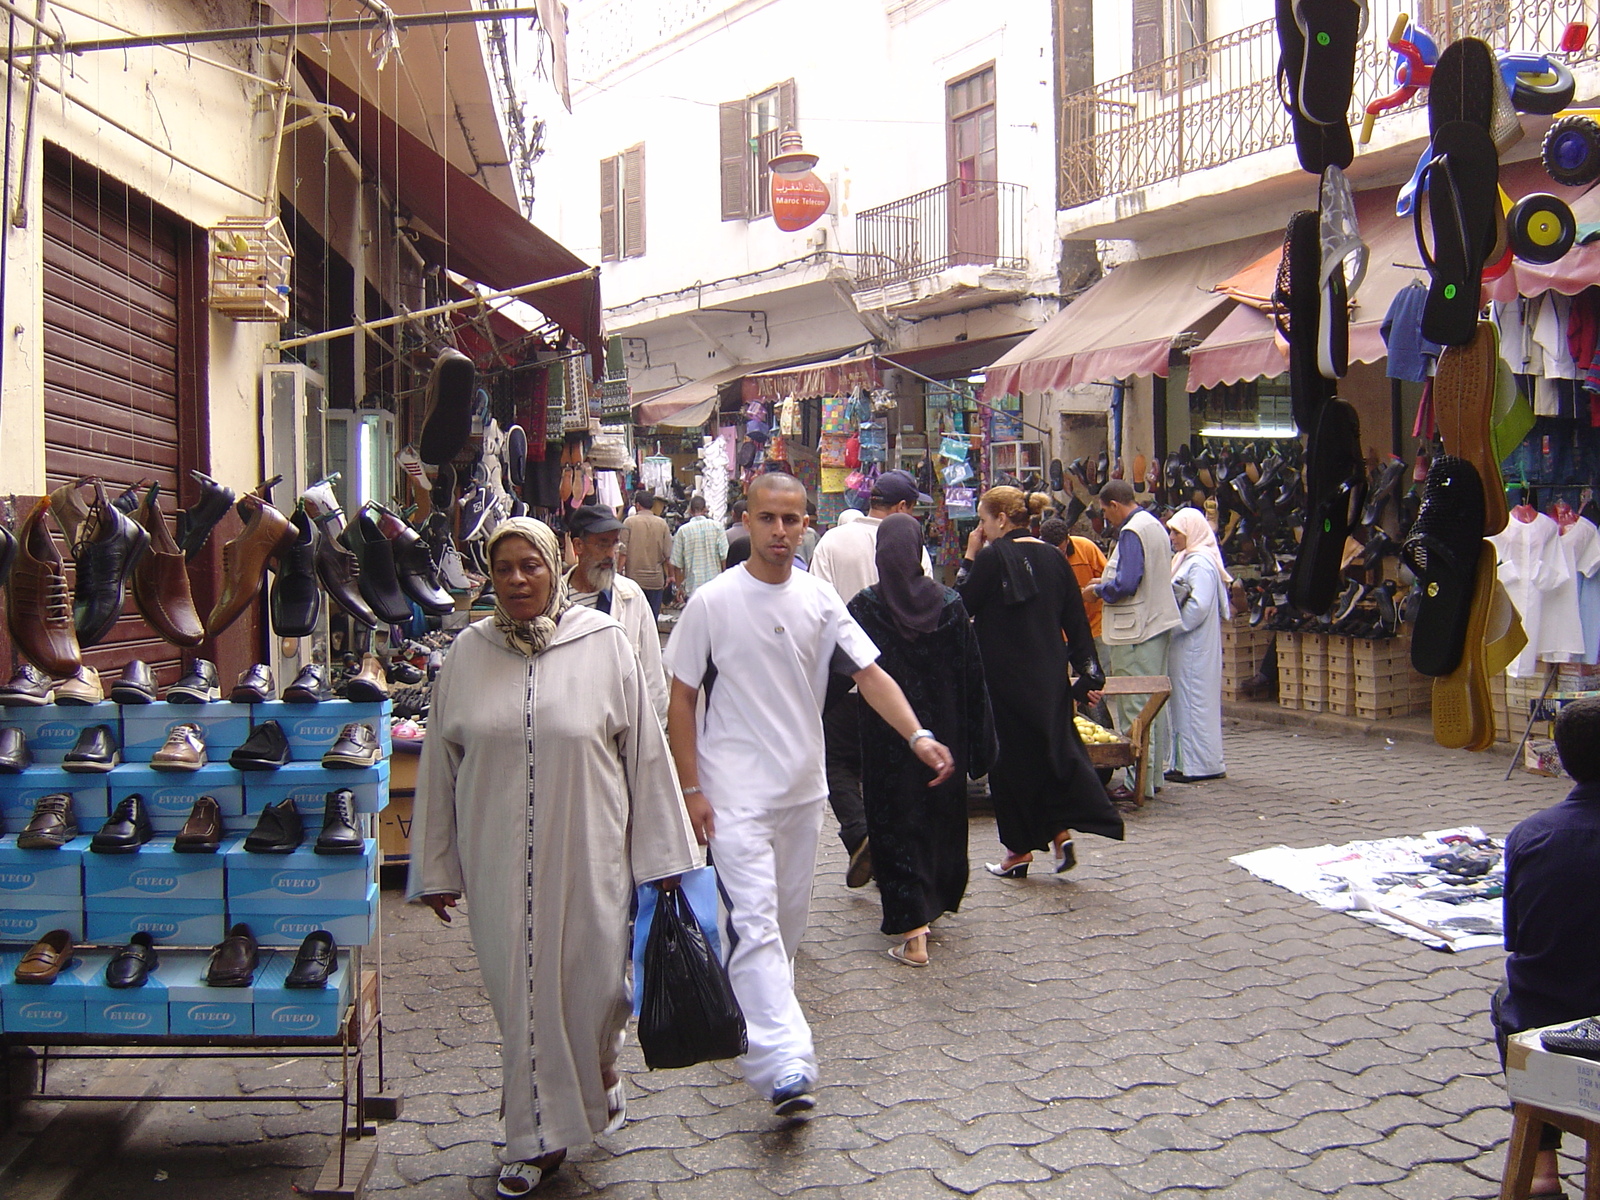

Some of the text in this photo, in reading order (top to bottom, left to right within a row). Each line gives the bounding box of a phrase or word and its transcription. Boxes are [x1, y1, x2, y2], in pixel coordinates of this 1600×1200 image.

[776, 197, 825, 206] Maroc Telecom
[41, 728, 75, 737] EVECO
[300, 726, 335, 735] EVECO
[158, 795, 195, 804] EVECO
[294, 794, 327, 802] EVEC
[0, 874, 31, 883] VECO
[136, 877, 174, 886] EVECO
[277, 879, 316, 888] EVECO
[136, 923, 175, 932] EVECO
[280, 924, 319, 932] EVECO
[26, 1010, 62, 1019] EVECO
[110, 1011, 146, 1020] EVECO
[194, 1012, 230, 1021] EVECO
[278, 1014, 315, 1022] EVECO
[1577, 1076, 1593, 1087] ITEM
